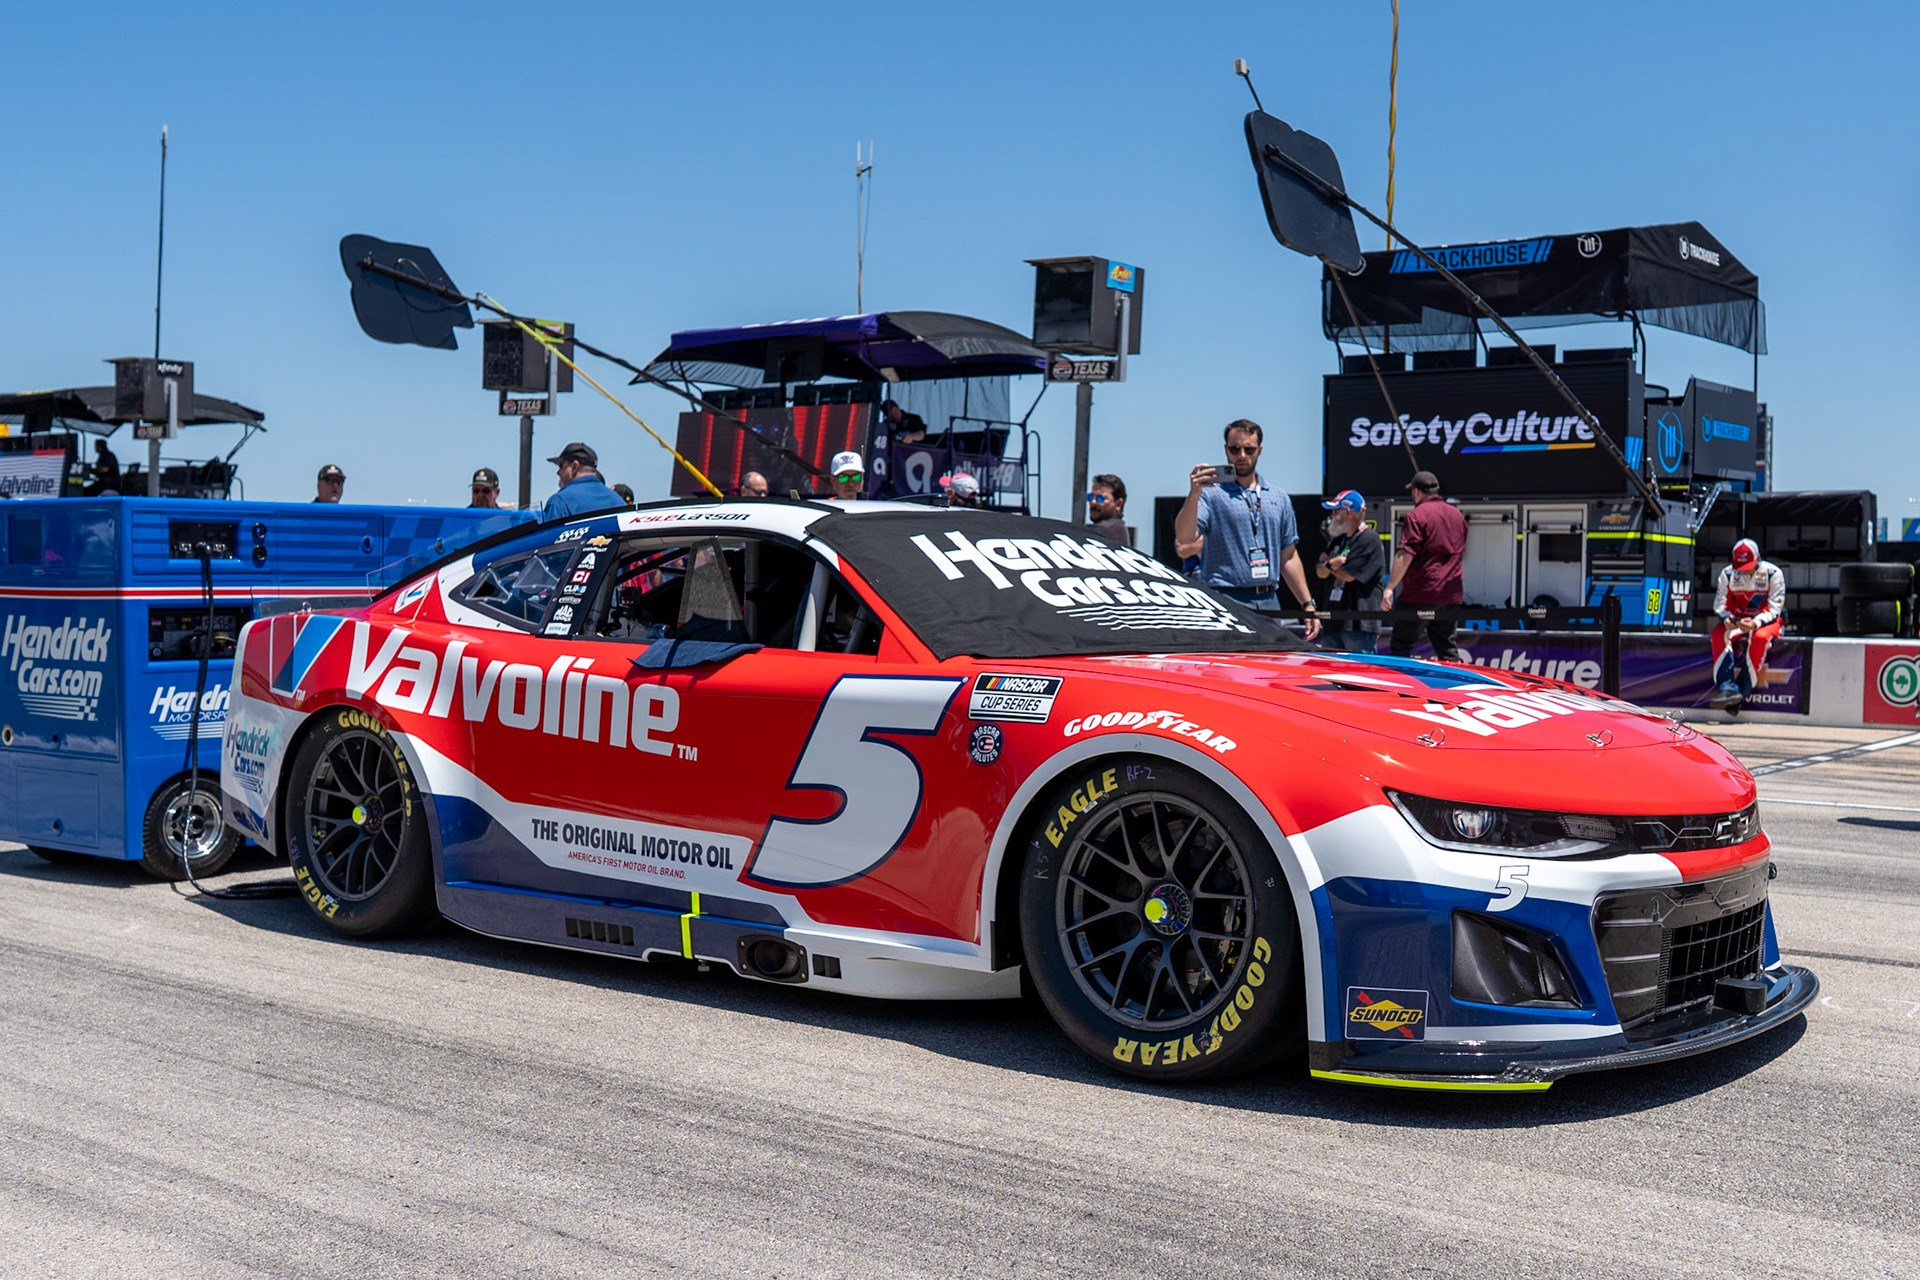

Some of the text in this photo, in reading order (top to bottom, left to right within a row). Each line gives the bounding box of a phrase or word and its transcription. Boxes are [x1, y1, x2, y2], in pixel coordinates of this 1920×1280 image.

[1414, 245, 1529, 270] TRACKHOUSE
[157, 363, 183, 375] xfinity
[1073, 362, 1109, 375] TEXAS
[517, 400, 542, 411] TEXAS
[874, 435, 887, 449] 48
[1349, 410, 1600, 455] SafetyCulture
[909, 530, 1189, 591] Hendrick
[1020, 569, 1228, 613] Cars.com
[1, 615, 112, 672] Hendrick
[18, 667, 103, 698] Cars.com
[345, 621, 681, 757] Valvoline
[1001, 677, 1049, 694] NASCAR
[149, 684, 231, 722] Hendri
[980, 696, 1042, 712] CUP SERIES
[1745, 693, 1795, 704] VROLET
[226, 722, 270, 758] Hendrick
[973, 726, 1000, 740] NASCAR
[1063, 710, 1237, 754] GOODYEAR
[234, 751, 266, 779] Cars.com
[677, 745, 698, 762] TM
[972, 747, 998, 762] SALUTES
[745, 673, 969, 889] 5
[1044, 767, 1119, 849] EAGLE
[531, 819, 733, 870] THE ORIGINAL MOTOR OIL
[567, 851, 686, 880] AMERICA'S FIRST MOTOR OIL BRAND.
[296, 866, 340, 919] EAGLE
[1486, 865, 1530, 912] 5
[1112, 936, 1272, 1066] GOODYEAR
[1351, 1007, 1423, 1024] SUNOCO
